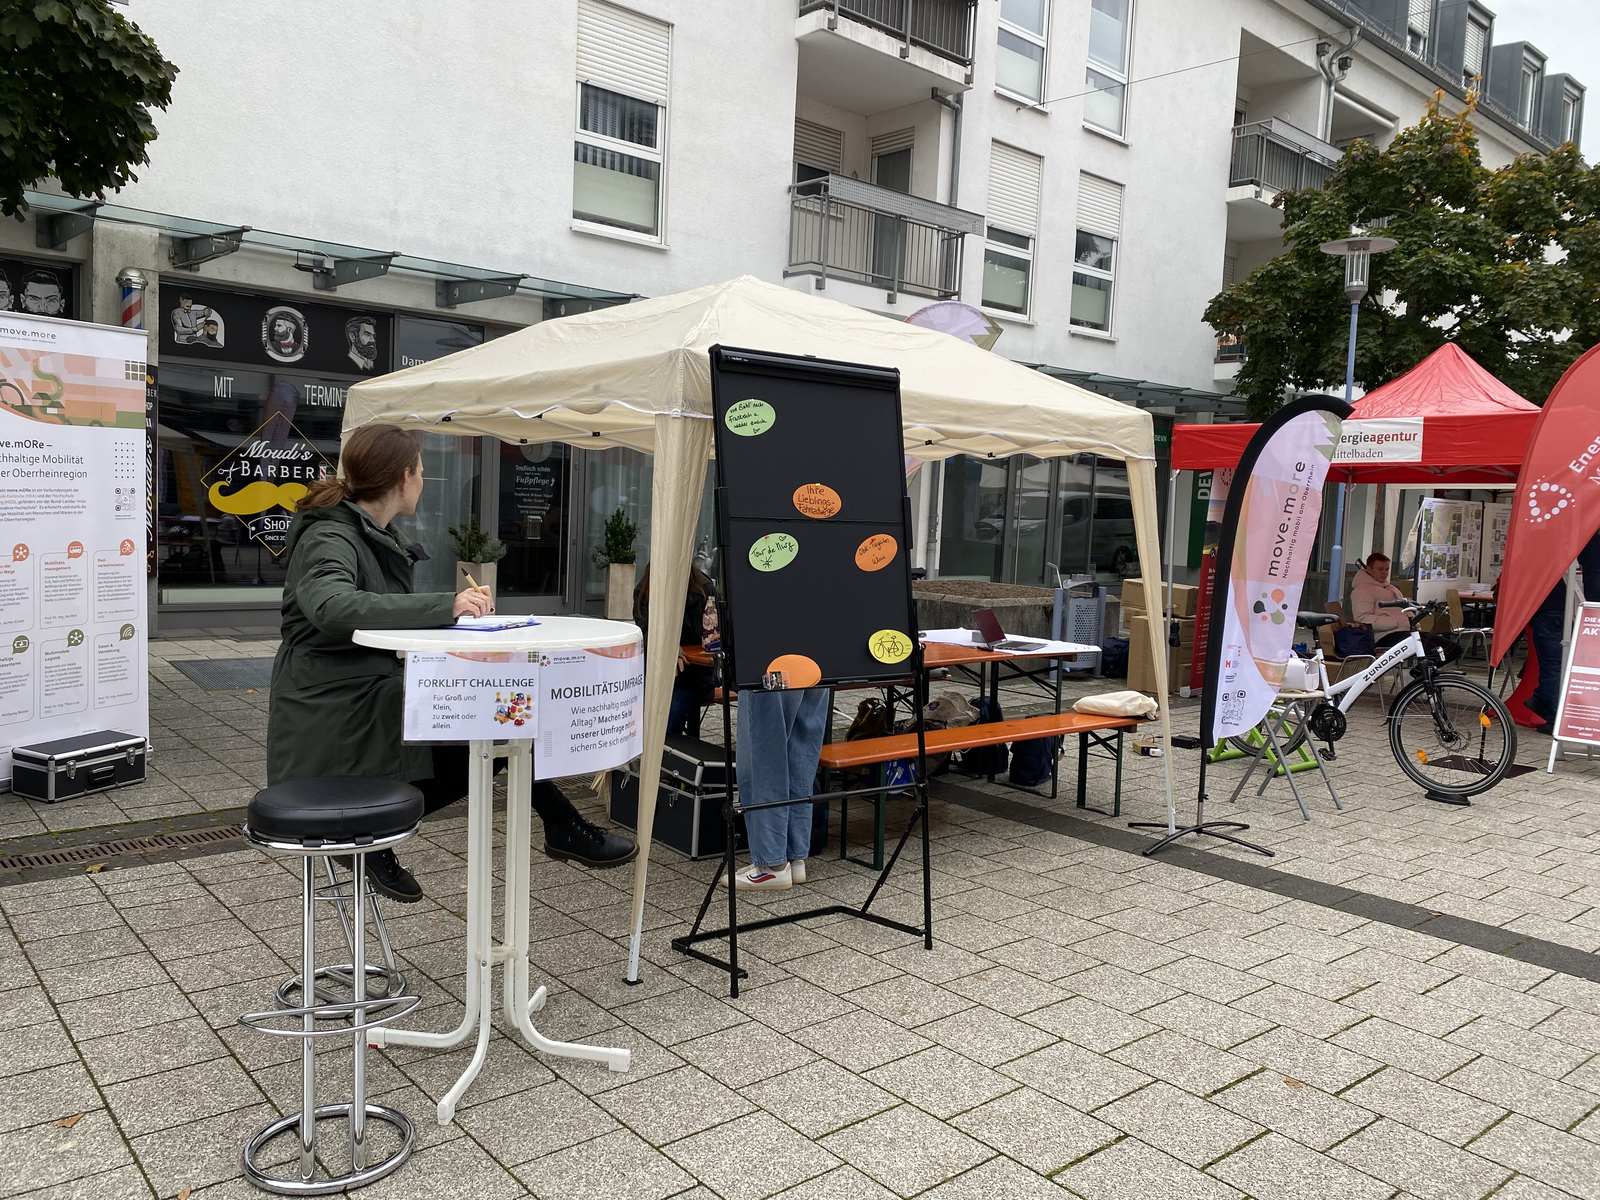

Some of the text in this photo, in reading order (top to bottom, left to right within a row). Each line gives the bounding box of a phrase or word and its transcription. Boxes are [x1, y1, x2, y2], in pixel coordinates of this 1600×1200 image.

[0, 327, 56, 339] move.more
[402, 355, 428, 366] Dam
[214, 376, 342, 408] MIT TERMIN
[0, 440, 44, 449] ve.mORe
[1340, 432, 1418, 444] ergieagentur
[240, 440, 314, 460] Moudi's
[1334, 448, 1384, 458] ittelbaden
[1568, 436, 1600, 474] Ener
[0, 453, 84, 466] hhaltige Mobilität
[12, 468, 87, 480] Oberrheinregion
[240, 460, 314, 479] BARBER
[516, 476, 550, 485] Fußpflege
[806, 485, 825, 495] Ihre
[1268, 462, 1306, 576] move.more
[1282, 464, 1314, 579] Nachhaltig mobil am Oberrhein
[751, 548, 766, 557] Tour
[768, 546, 775, 554] de
[1362, 645, 1408, 682] ZÜNDAPP
[418, 678, 534, 687] FORKLIFT CHALLENGE
[551, 674, 642, 700] MOBILITÄTSUMFRAGE
[571, 706, 586, 714] Wie
[588, 701, 619, 713] nachhaltig
[571, 717, 596, 728] Alltag?
[598, 713, 621, 724] Machen
[570, 730, 600, 740] unserer
[600, 725, 624, 736] Umfrage
[570, 742, 597, 752] sichern
[598, 740, 608, 749] Sie
[609, 737, 619, 747] sich
